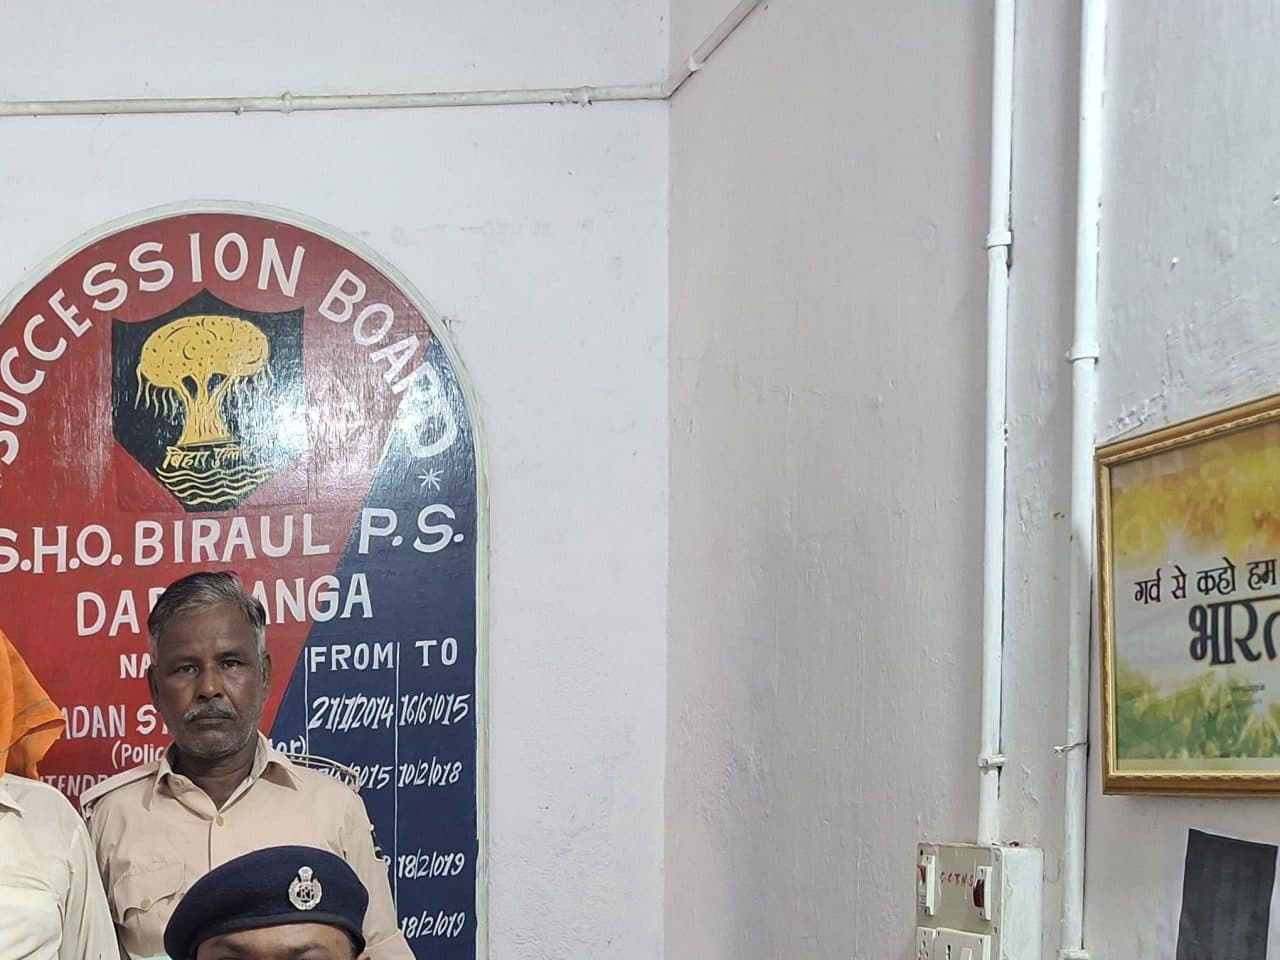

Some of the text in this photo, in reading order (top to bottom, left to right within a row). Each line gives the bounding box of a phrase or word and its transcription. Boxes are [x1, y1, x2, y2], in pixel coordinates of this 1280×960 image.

[317, 268, 457, 459] BOARD
[134, 511, 331, 567] BIRAUL
[1134, 556, 1277, 604] गर्व से कहो हम
[77, 573, 374, 637] DAANGA
[120, 653, 152, 679] NA
[310, 642, 394, 673] FROM
[415, 637, 458, 667] TO
[57, 704, 126, 740] ADAN
[112, 740, 164, 769] (Polic
